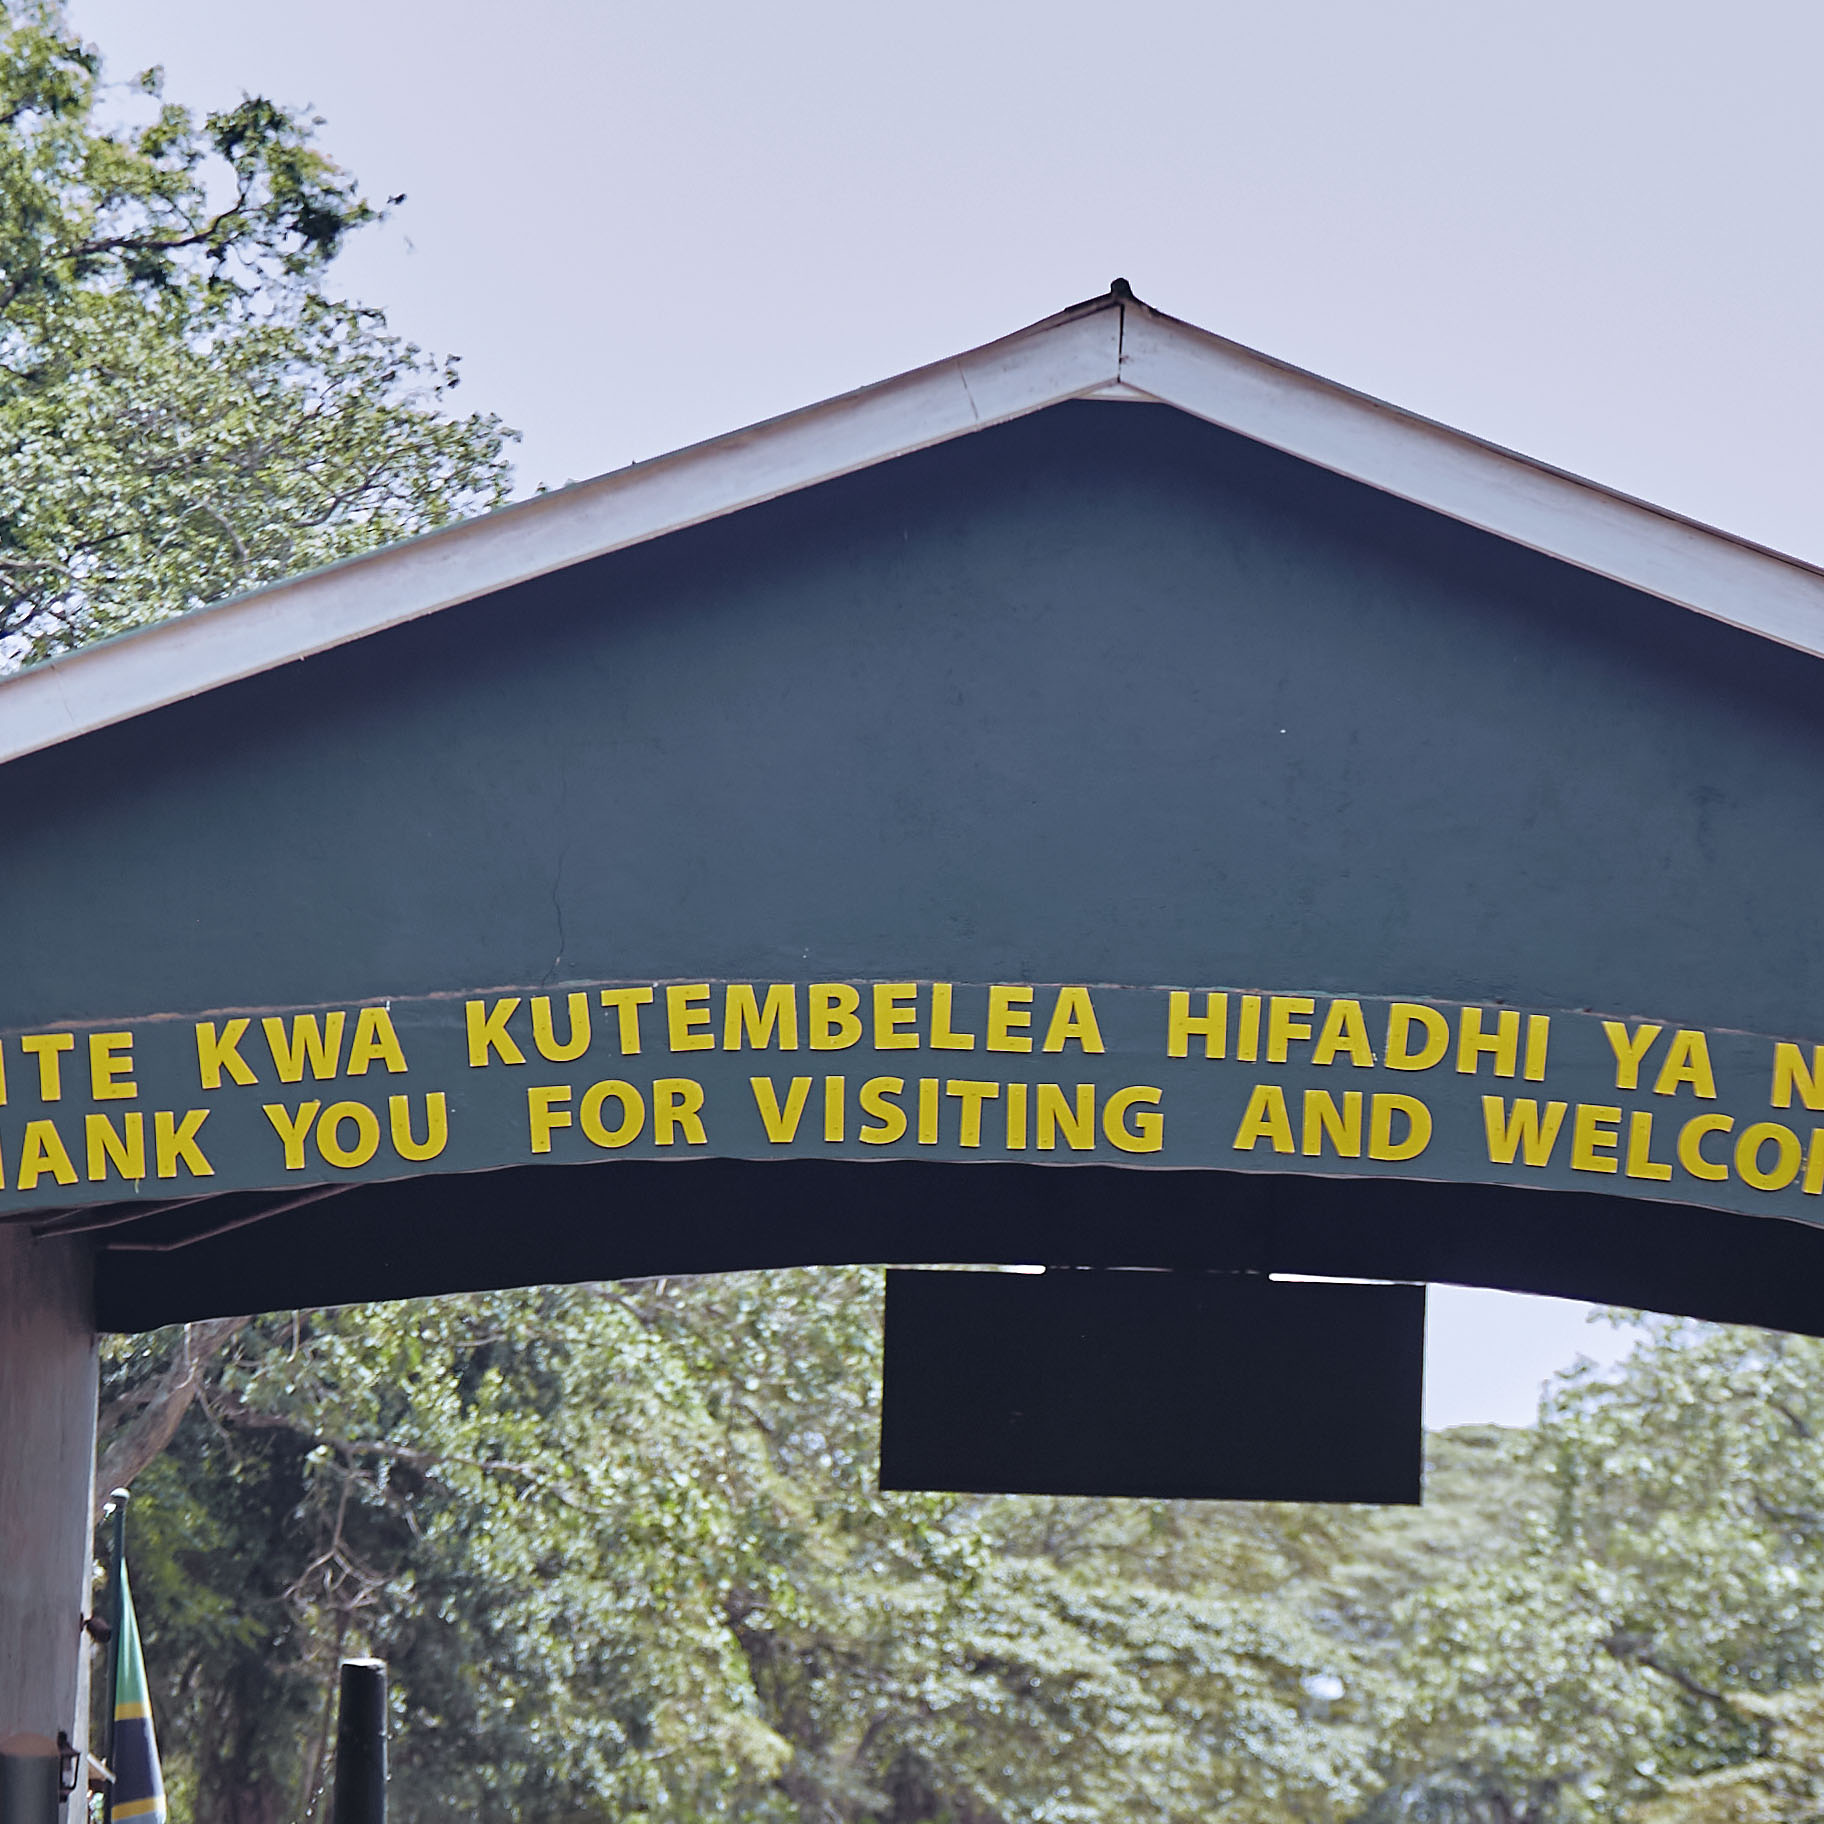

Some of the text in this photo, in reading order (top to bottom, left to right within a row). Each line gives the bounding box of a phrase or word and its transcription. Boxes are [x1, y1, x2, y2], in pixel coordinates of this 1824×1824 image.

[196, 1007, 408, 1090] KWA
[465, 983, 1105, 1067] KUTEMBELEA
[1167, 991, 1550, 1082] HIFADHI
[1602, 1020, 1717, 1099] YA
[263, 1091, 448, 1170] YOU
[527, 1077, 707, 1154] FOR
[750, 1075, 1164, 1153] VISITING
[1232, 1084, 1433, 1162] AND
